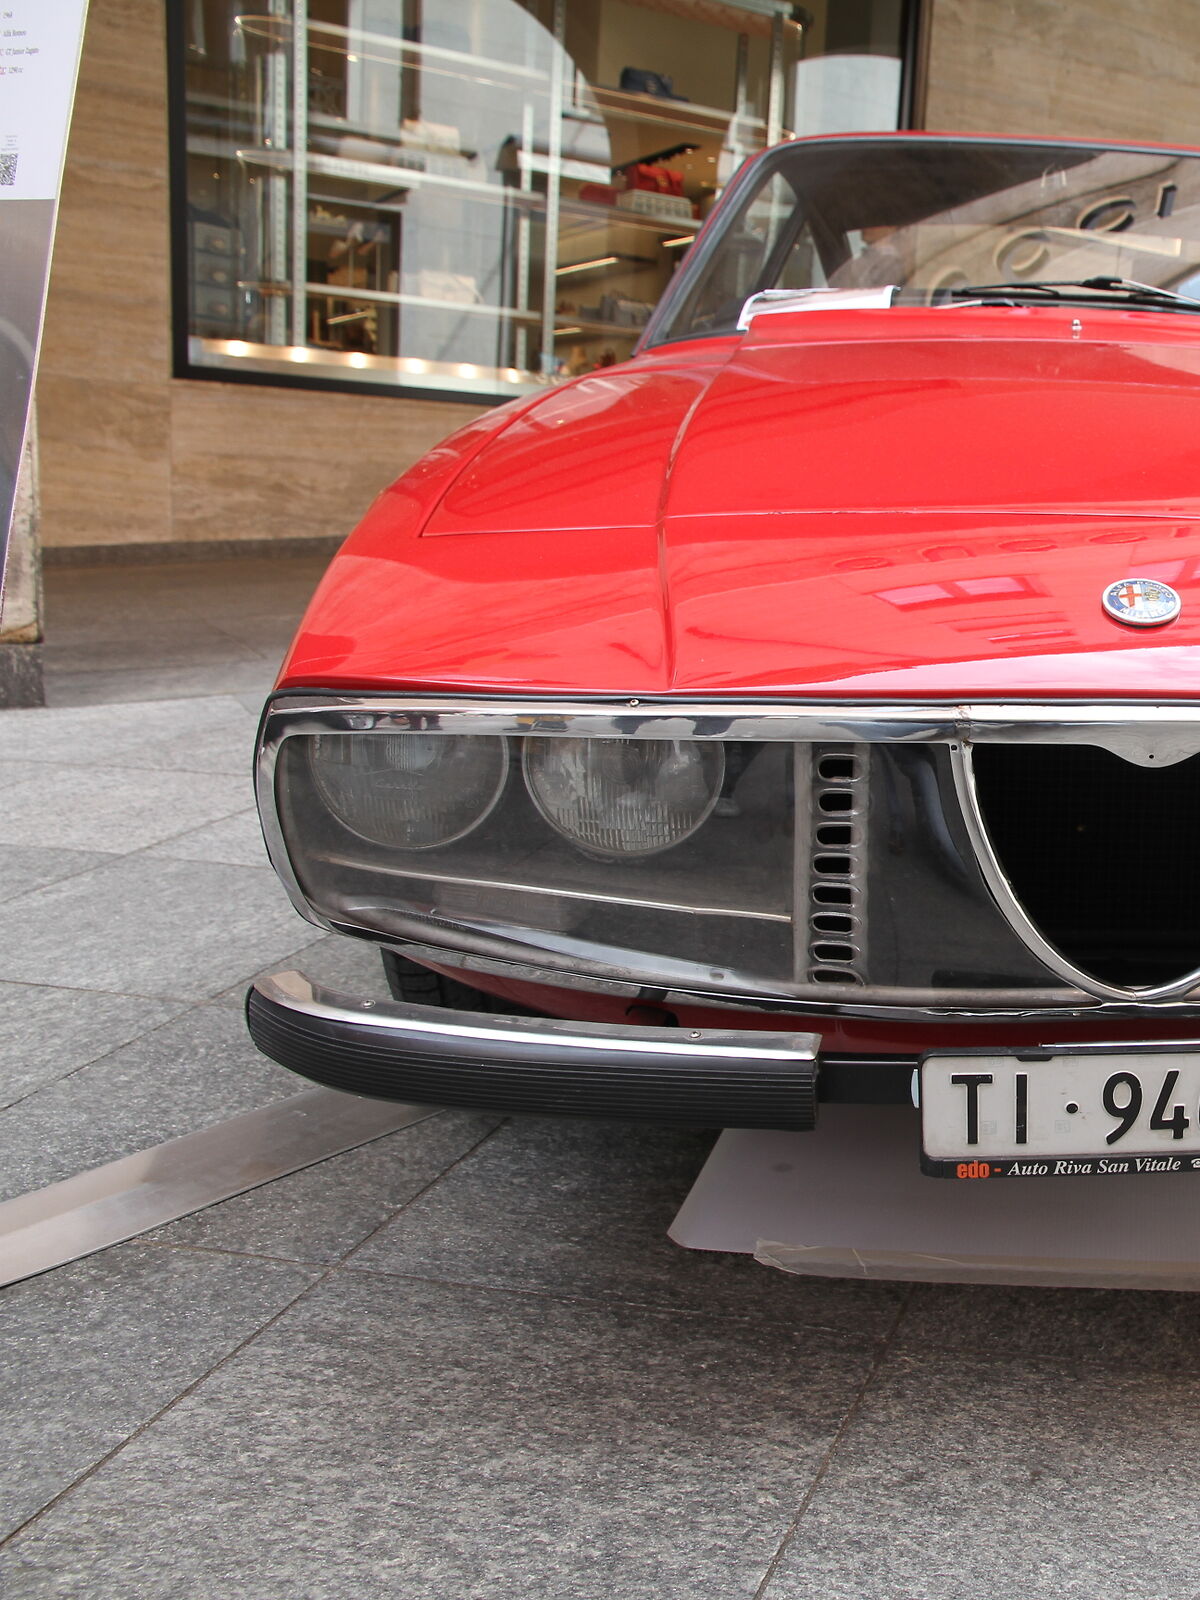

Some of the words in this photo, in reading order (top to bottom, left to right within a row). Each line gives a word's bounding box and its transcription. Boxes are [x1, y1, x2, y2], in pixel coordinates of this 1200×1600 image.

[950, 1072, 1029, 1145] TI
[955, 1160, 991, 1179] edo
[1007, 1161, 1049, 1176] Auto
[1053, 1159, 1093, 1176] Riva
[1096, 1158, 1130, 1174] San
[1134, 1156, 1182, 1173] Vitale
